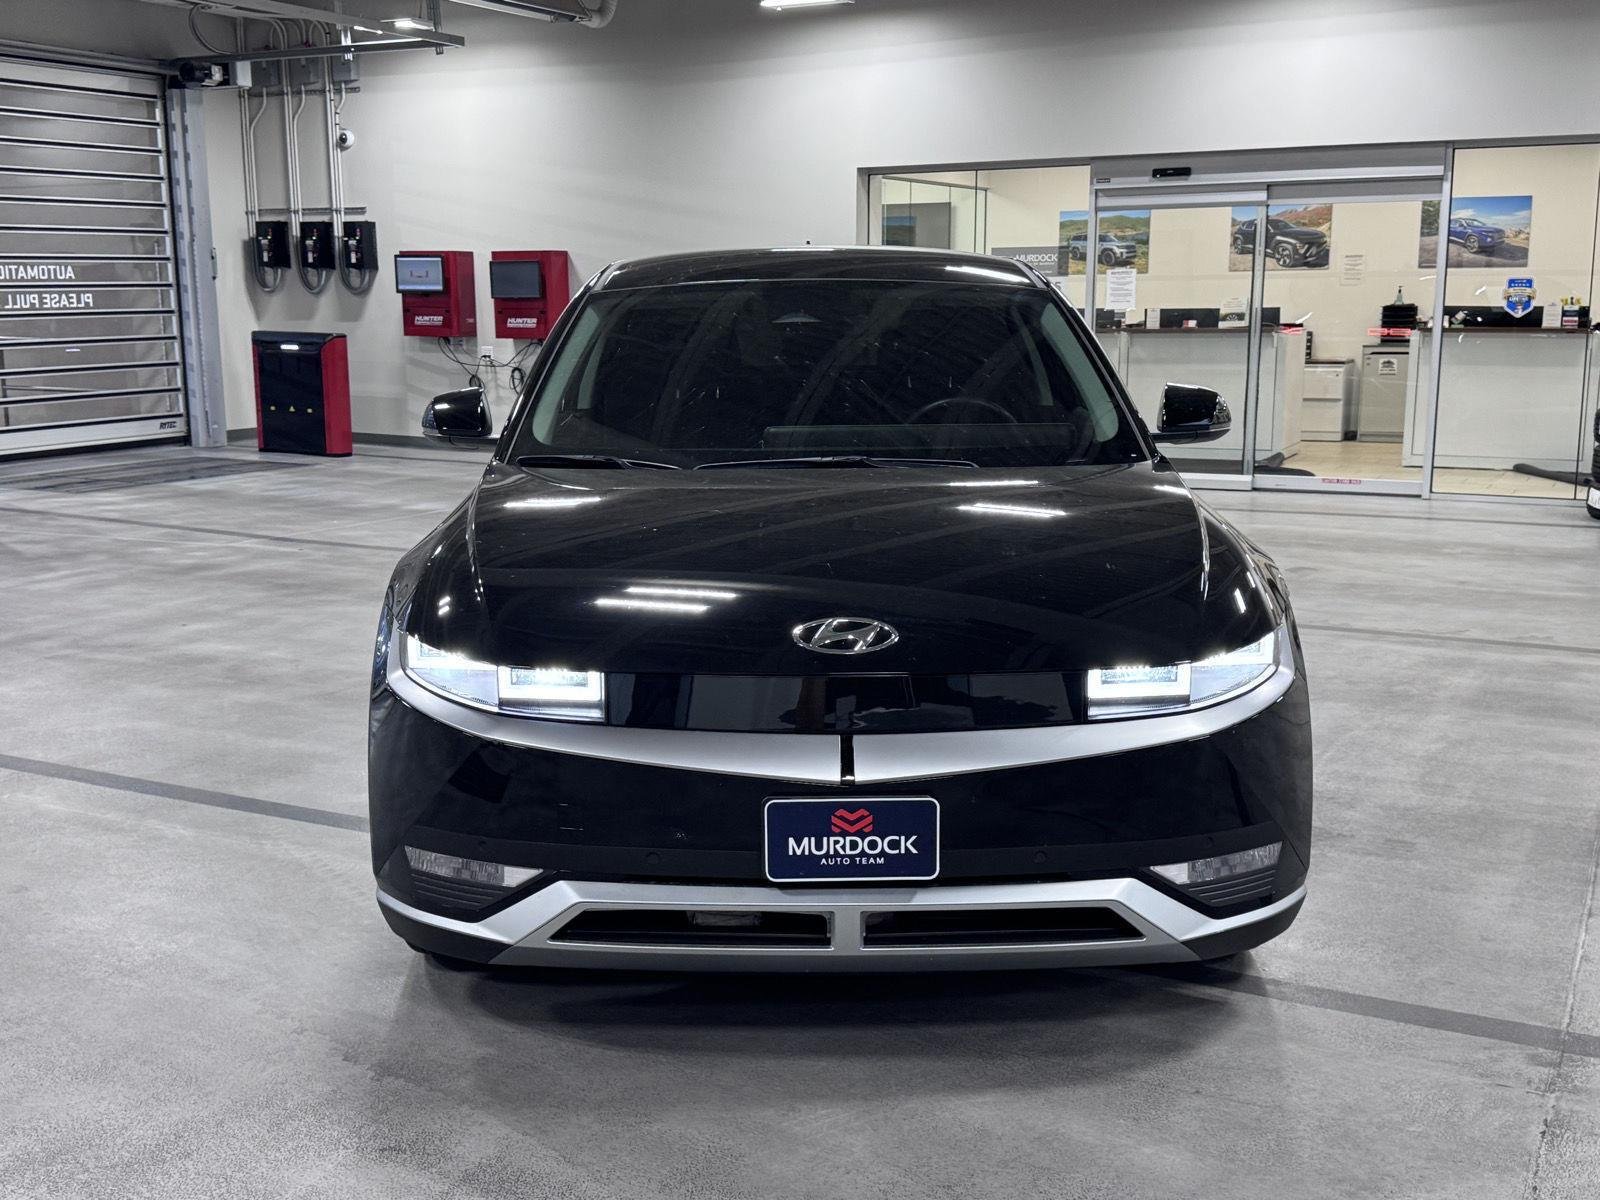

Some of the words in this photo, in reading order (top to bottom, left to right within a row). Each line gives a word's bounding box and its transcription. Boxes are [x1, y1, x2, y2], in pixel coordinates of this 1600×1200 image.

[414, 315, 444, 323] HUNTER
[507, 317, 538, 325] HUNTER
[788, 835, 918, 855] MURDOCK
[820, 857, 850, 865] AUTO
